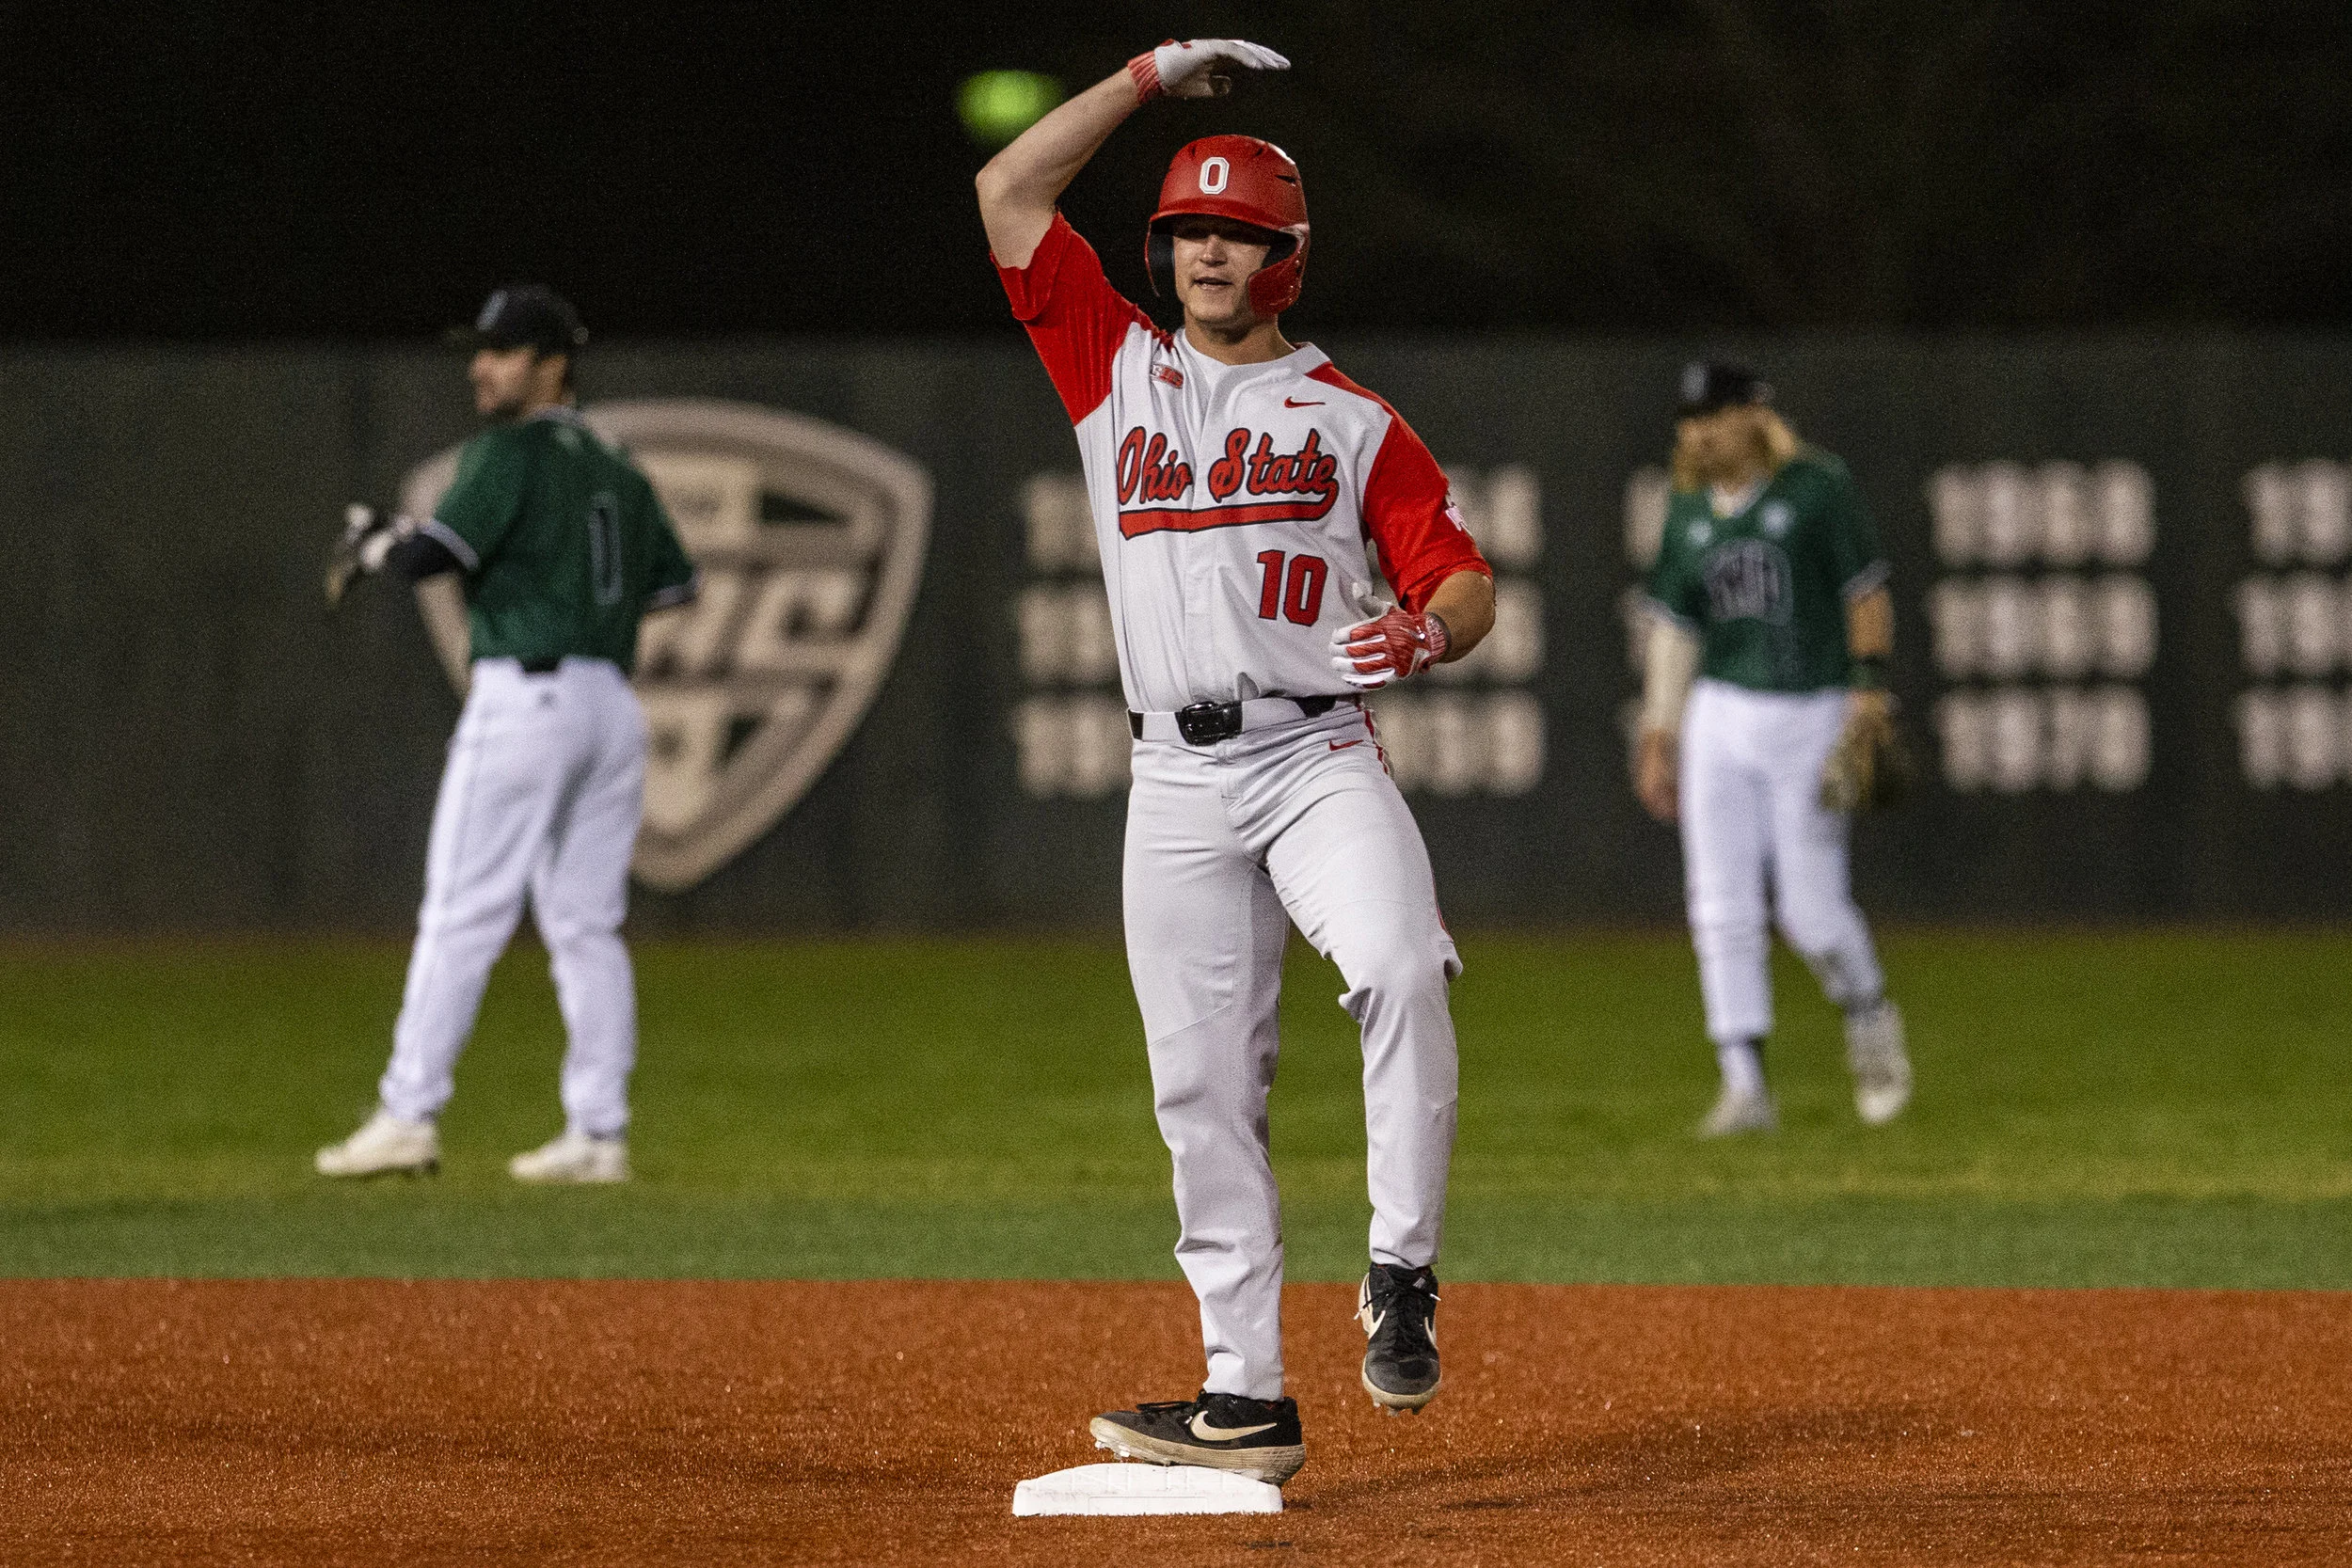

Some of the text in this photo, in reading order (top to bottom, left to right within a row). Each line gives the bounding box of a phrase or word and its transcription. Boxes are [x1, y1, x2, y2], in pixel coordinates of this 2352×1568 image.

[1199, 156, 1230, 195] O
[1117, 426, 1340, 505] Ohio State
[1257, 548, 1328, 627] 10
